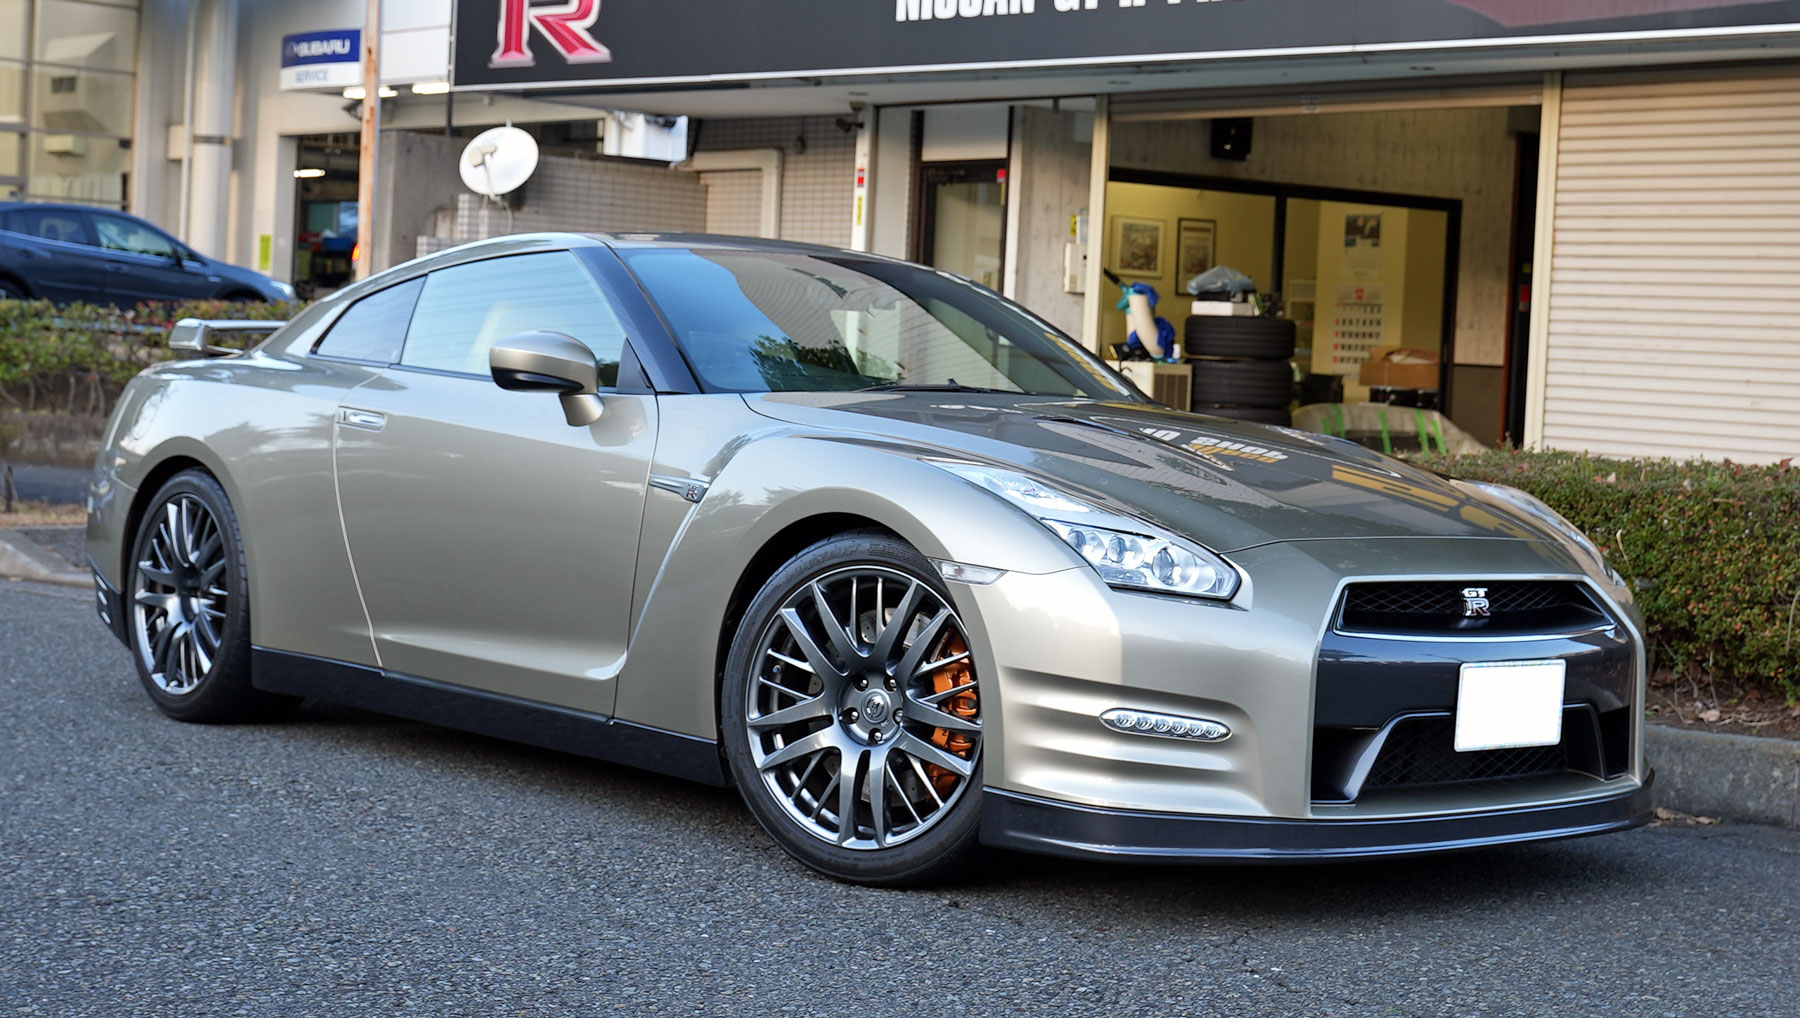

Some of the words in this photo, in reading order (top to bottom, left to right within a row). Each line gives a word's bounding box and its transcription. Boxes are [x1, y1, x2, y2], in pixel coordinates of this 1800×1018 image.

[298, 39, 350, 57] SUBARU
[1462, 587, 1489, 598] GT
[1464, 598, 1491, 616] R
